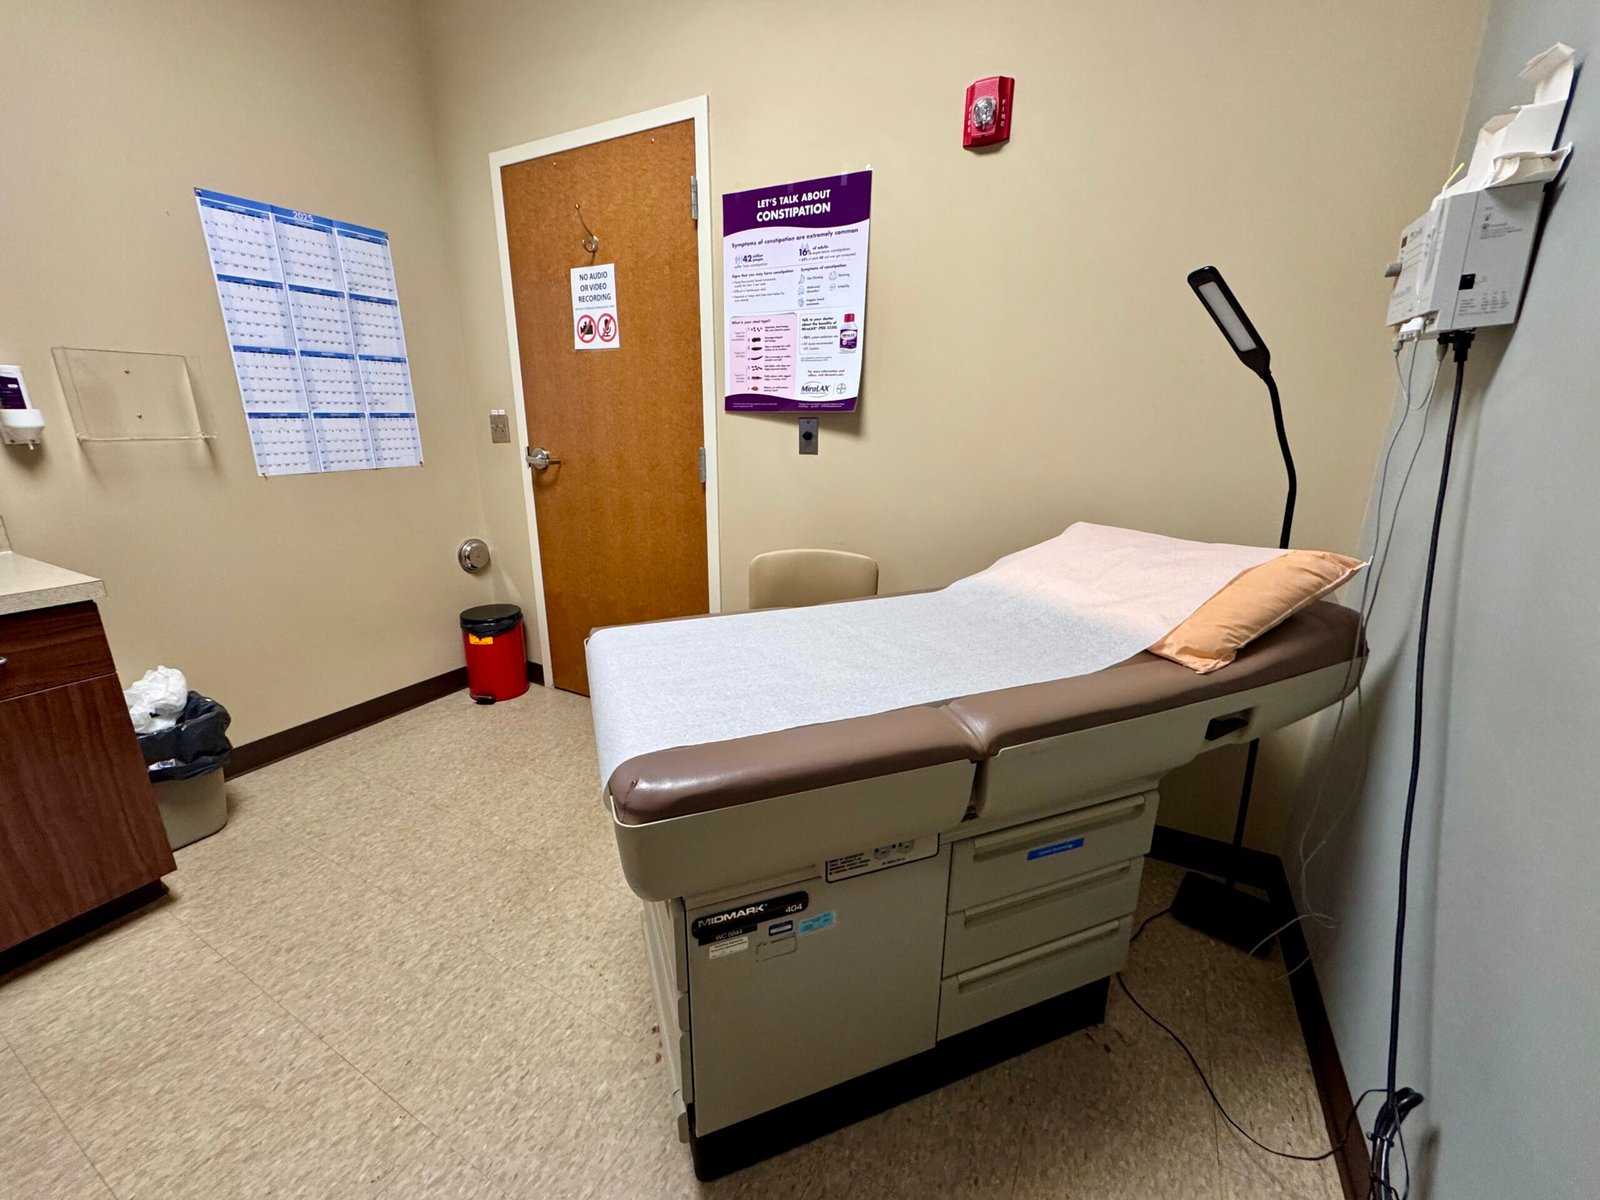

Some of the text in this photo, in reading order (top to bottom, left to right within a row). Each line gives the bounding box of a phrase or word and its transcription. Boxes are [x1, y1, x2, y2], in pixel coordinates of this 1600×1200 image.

[757, 189, 831, 208] LET'S TALK ABOUT
[292, 211, 314, 222] 2025
[756, 202, 831, 222] CONSTIPATION
[764, 236, 795, 244] constipation
[806, 230, 833, 239] extremely
[589, 271, 608, 279] AUDIO
[589, 282, 607, 291] VIDEO
[578, 293, 611, 303] RECORDING
[698, 903, 803, 928] MIDMARK 404
